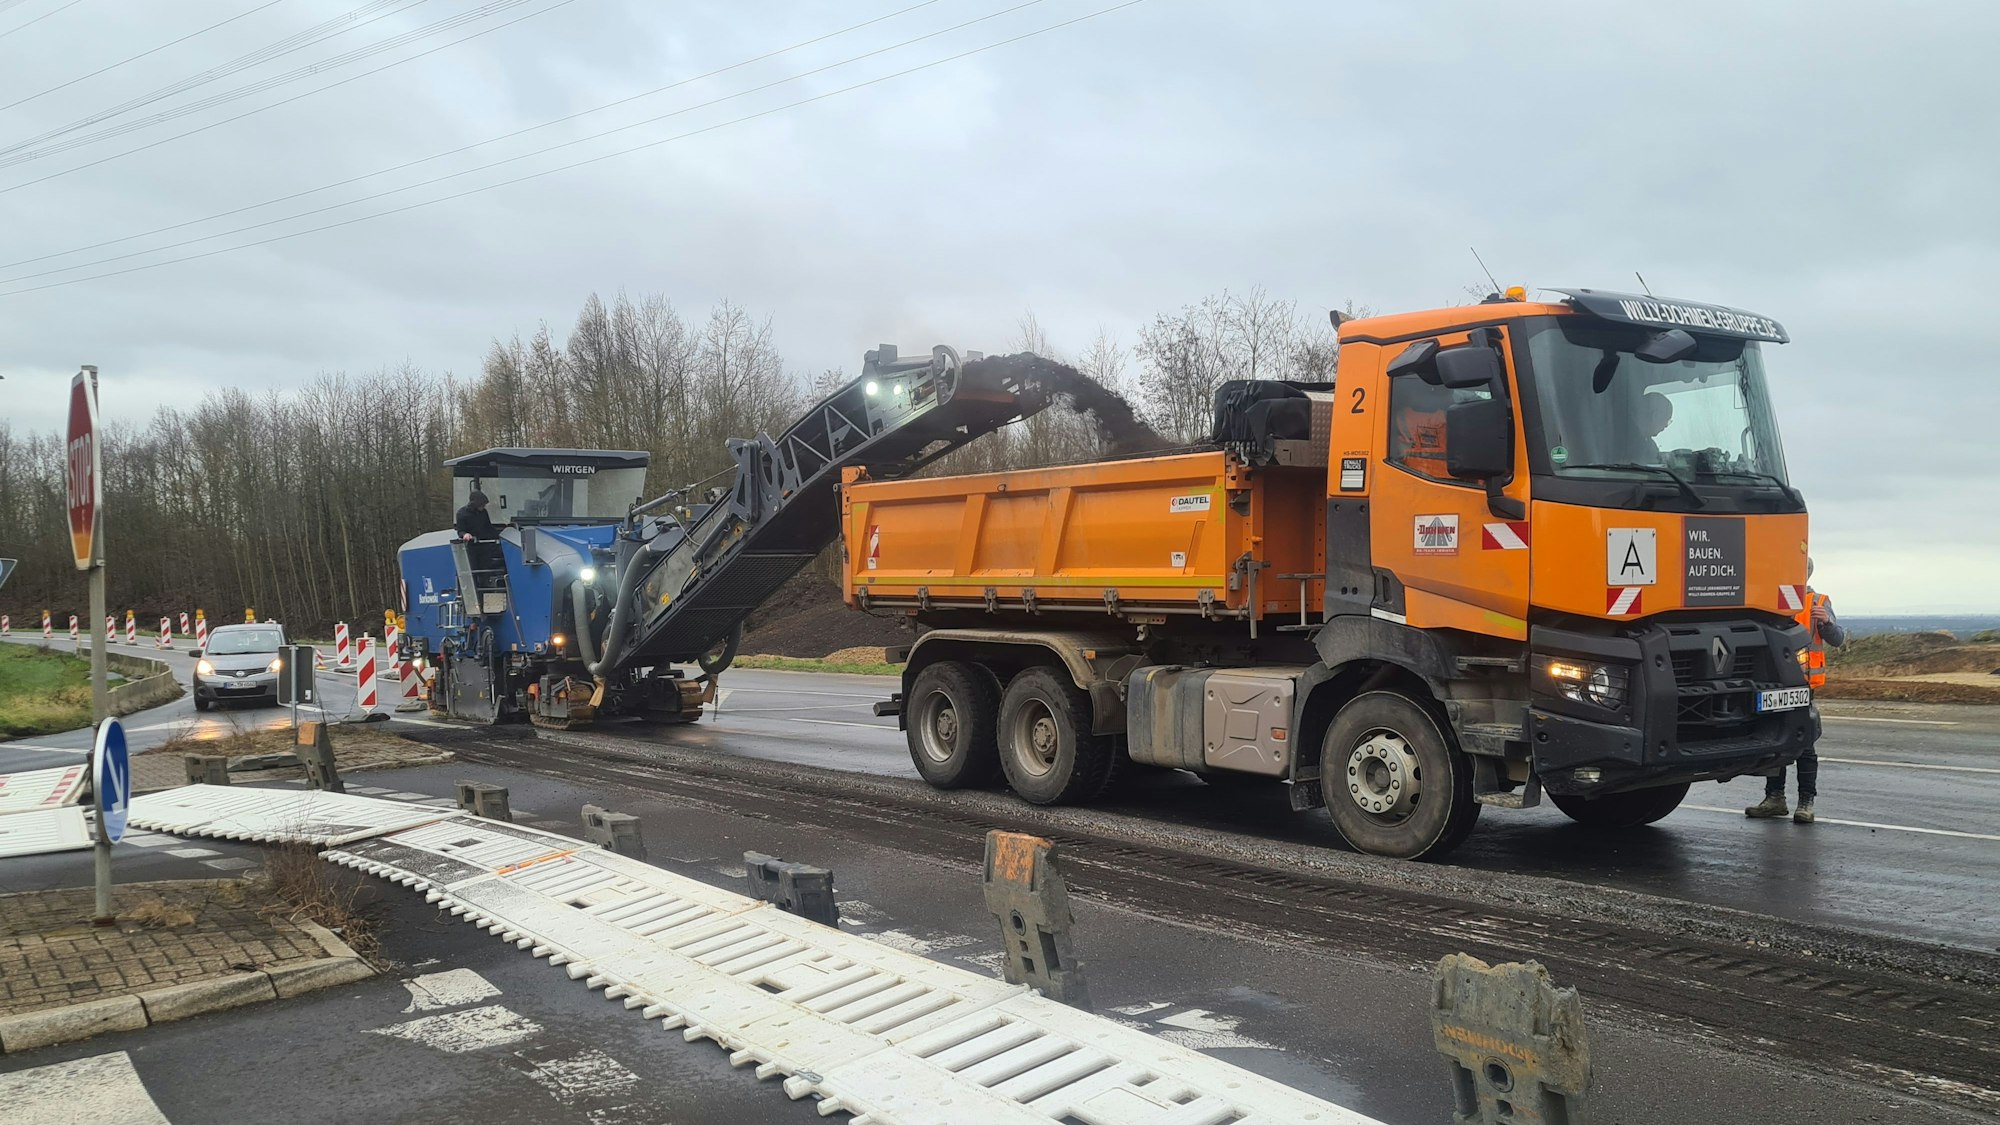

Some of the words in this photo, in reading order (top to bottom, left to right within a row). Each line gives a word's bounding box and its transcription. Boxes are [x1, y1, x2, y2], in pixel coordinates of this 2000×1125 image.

[1619, 299, 1782, 339] WILLY-DOHMEN-GRUPPE.DE
[1351, 387, 1366, 414] 2
[69, 432, 92, 509] STOP
[552, 464, 596, 474] WIRTGEN
[1178, 496, 1209, 506] DAUTEL
[1688, 530, 1711, 542] WIR.
[1620, 536, 1644, 576] A
[1688, 547, 1724, 560] BAUEN.
[1688, 564, 1708, 577] AUF
[1710, 564, 1737, 577] DICH.
[1762, 693, 1773, 708] HS
